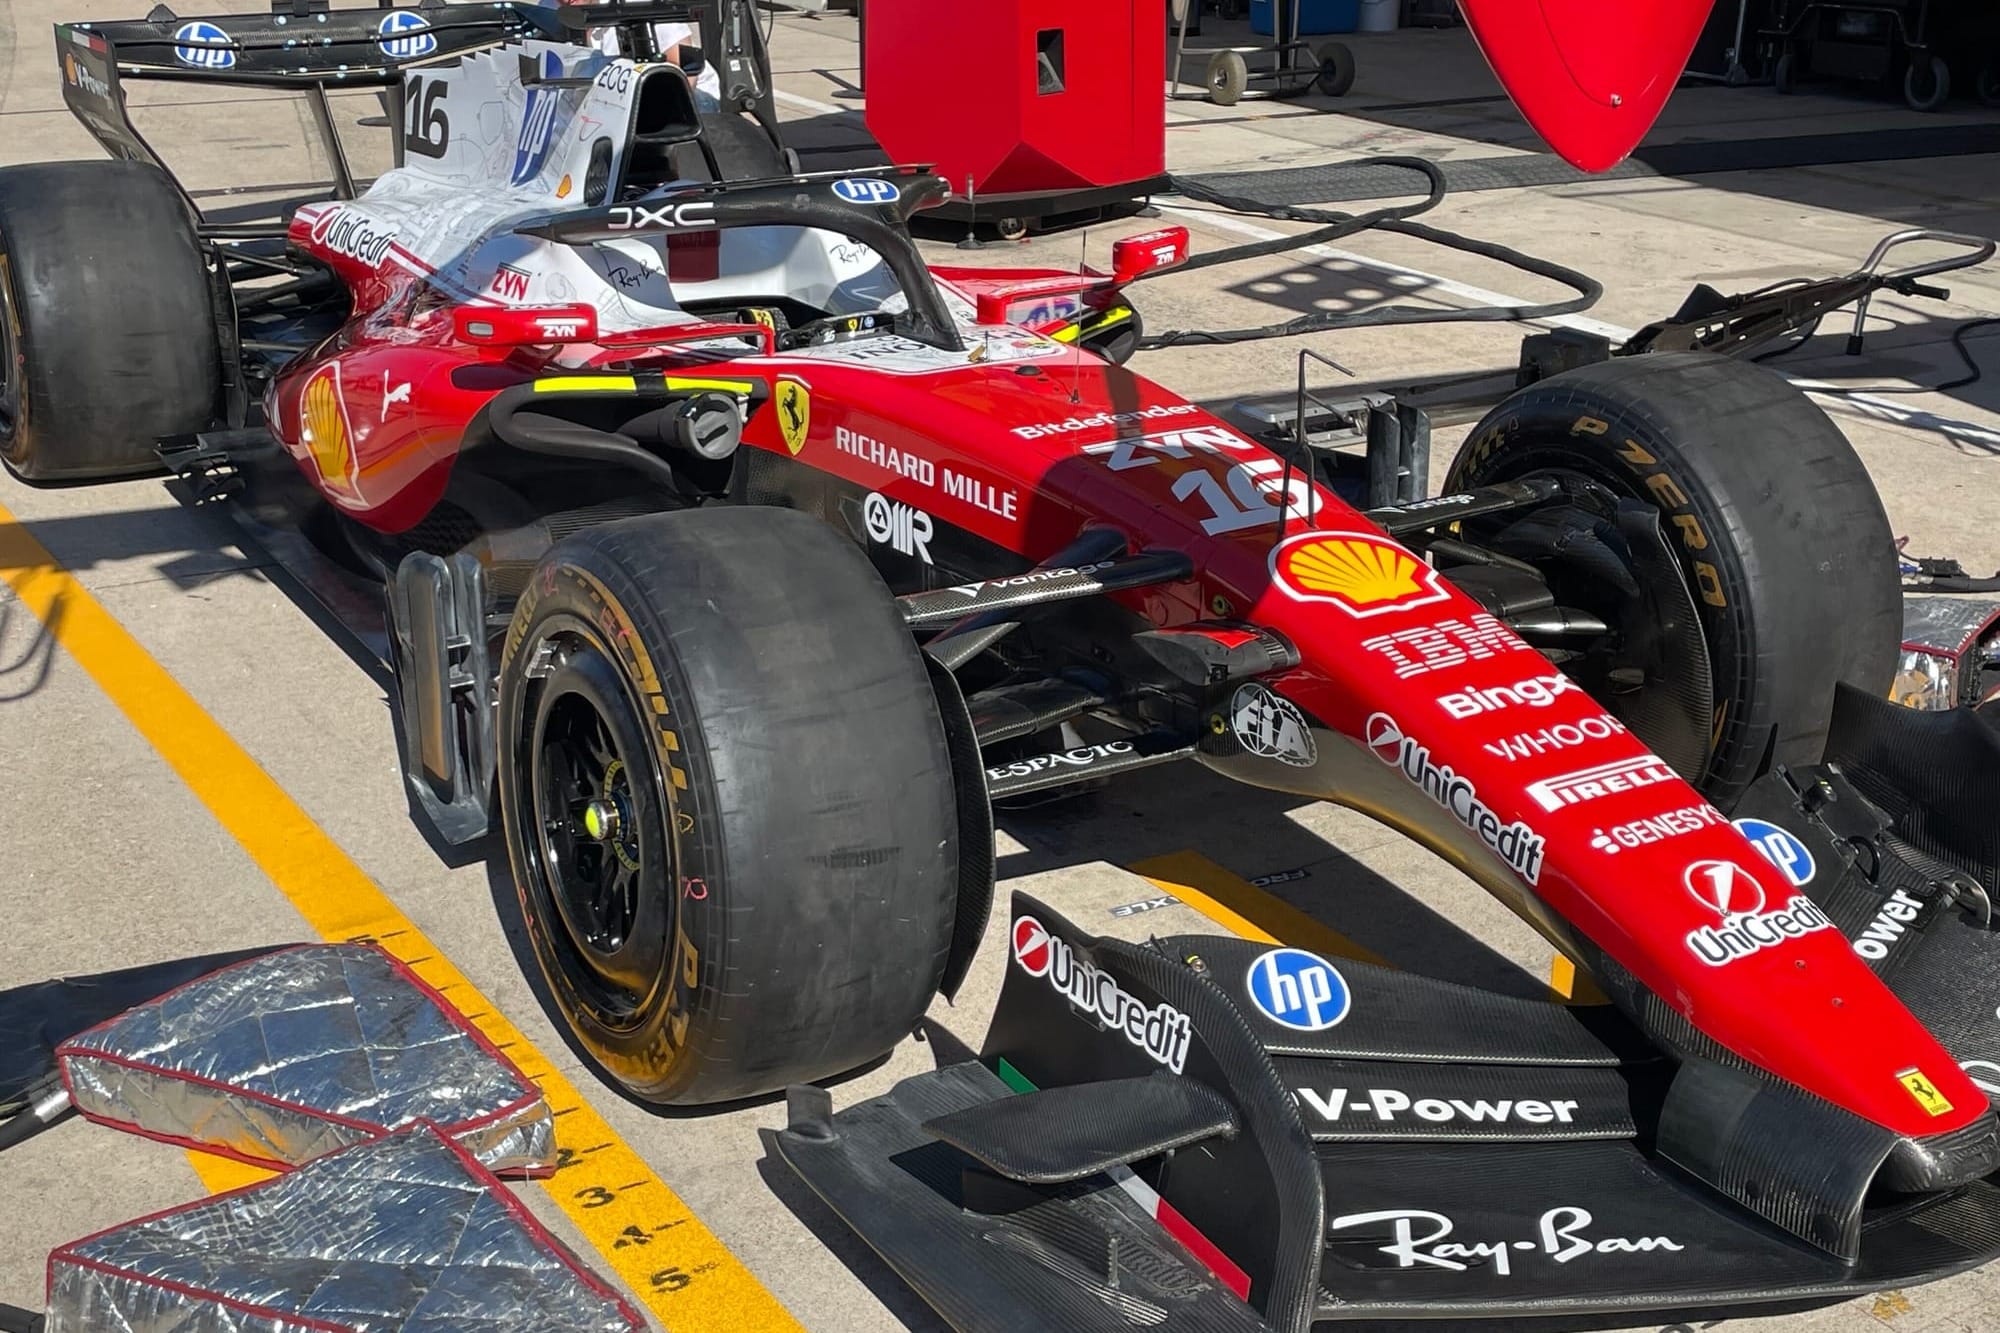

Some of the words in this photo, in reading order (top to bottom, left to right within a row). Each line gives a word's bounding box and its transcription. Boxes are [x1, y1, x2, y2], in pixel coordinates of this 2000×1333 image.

[185, 24, 226, 68] hp
[391, 12, 427, 56] hp
[406, 74, 448, 159] 16
[845, 179, 892, 202] hp
[608, 202, 715, 230] DXC
[1156, 252, 1174, 266] ZYN
[491, 269, 530, 301] ZYN
[543, 325, 576, 337] ZYN
[1010, 402, 1199, 440] Bitdefender
[1104, 427, 1254, 471] ZYN
[836, 425, 935, 487] RICHARD
[943, 467, 1018, 522] MILLE
[1171, 458, 1324, 536] 16
[1361, 613, 1533, 680] IBM
[1484, 713, 1626, 762] WHOOP
[1526, 754, 1683, 813] PIRELLI
[1402, 738, 1546, 885] UniCredit
[1612, 804, 1731, 848] GENESYS
[1687, 895, 1835, 965] UniCredit
[1853, 889, 1924, 960] ower
[1050, 936, 1191, 1075] UniCredit
[1264, 952, 1333, 1028] hp
[1297, 1087, 1579, 1123] V-Power
[574, 1186, 616, 1209] 3
[613, 1225, 653, 1250] 4
[1332, 1206, 1684, 1276] Ray-Ban
